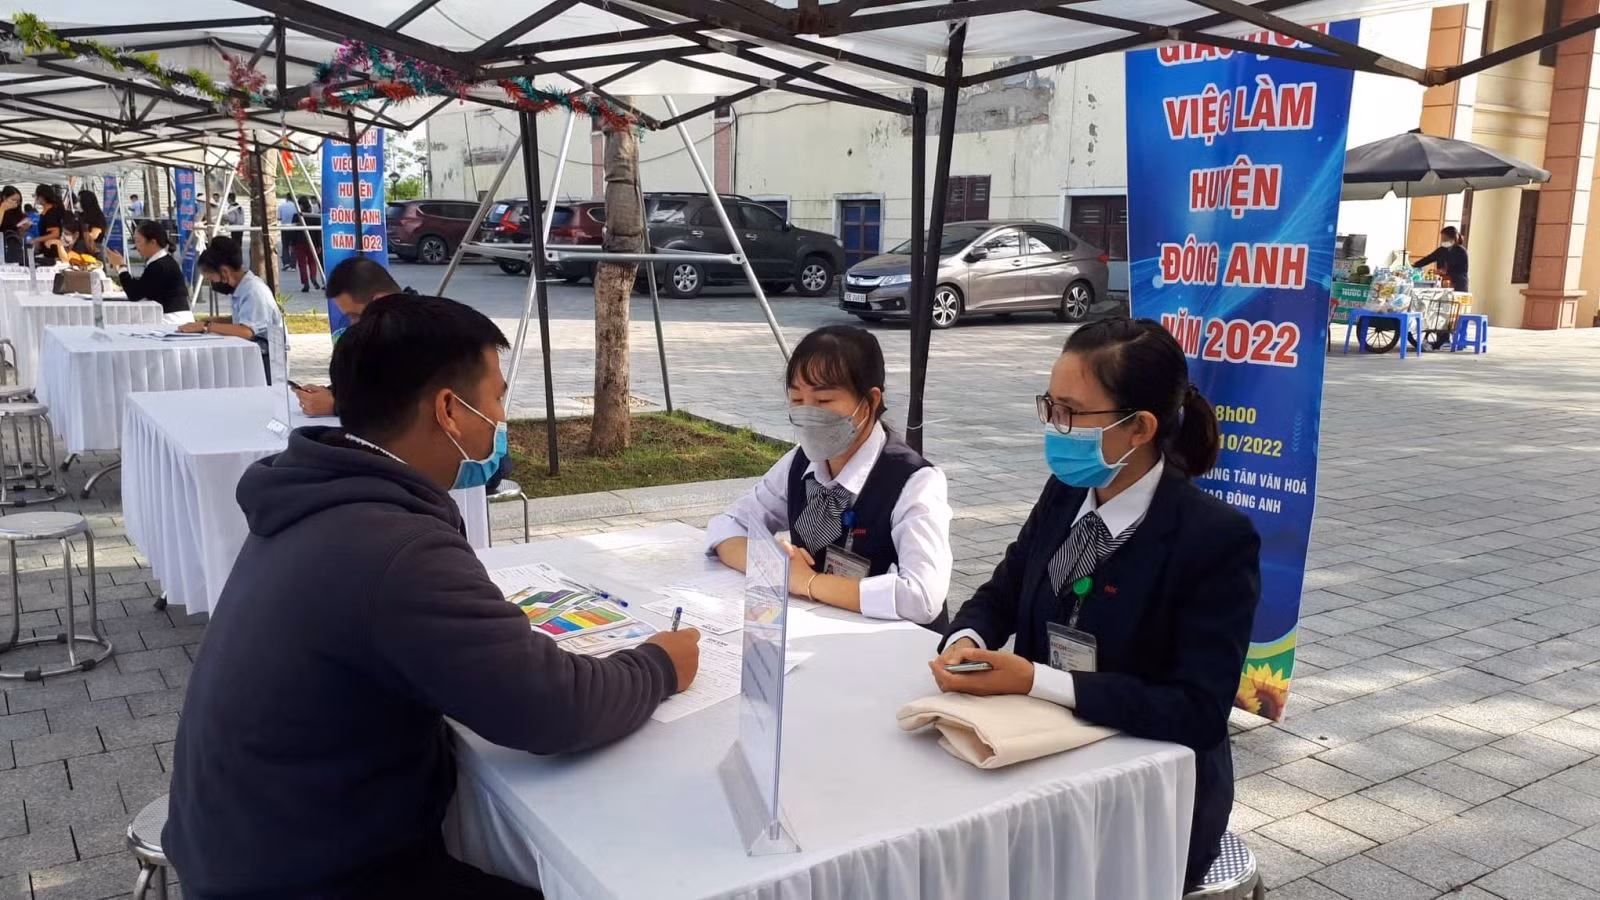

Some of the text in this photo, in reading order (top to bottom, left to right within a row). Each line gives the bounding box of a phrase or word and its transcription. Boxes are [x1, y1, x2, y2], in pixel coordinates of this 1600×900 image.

[1163, 74, 1317, 145] VIỆC LÀM
[338, 179, 373, 202] HUỆN
[1189, 154, 1282, 219] HUYỆN
[361, 207, 381, 225] ANH
[362, 235, 383, 252] 022
[1159, 233, 1308, 289] ĐÔNG ANH
[1202, 317, 1300, 367] 2022
[1215, 404, 1257, 424] 8h00
[1234, 467, 1257, 486] TÂM
[1260, 472, 1281, 490] VĂN
[1226, 489, 1256, 509] ĐÔNG
[1258, 496, 1281, 514] ANH
